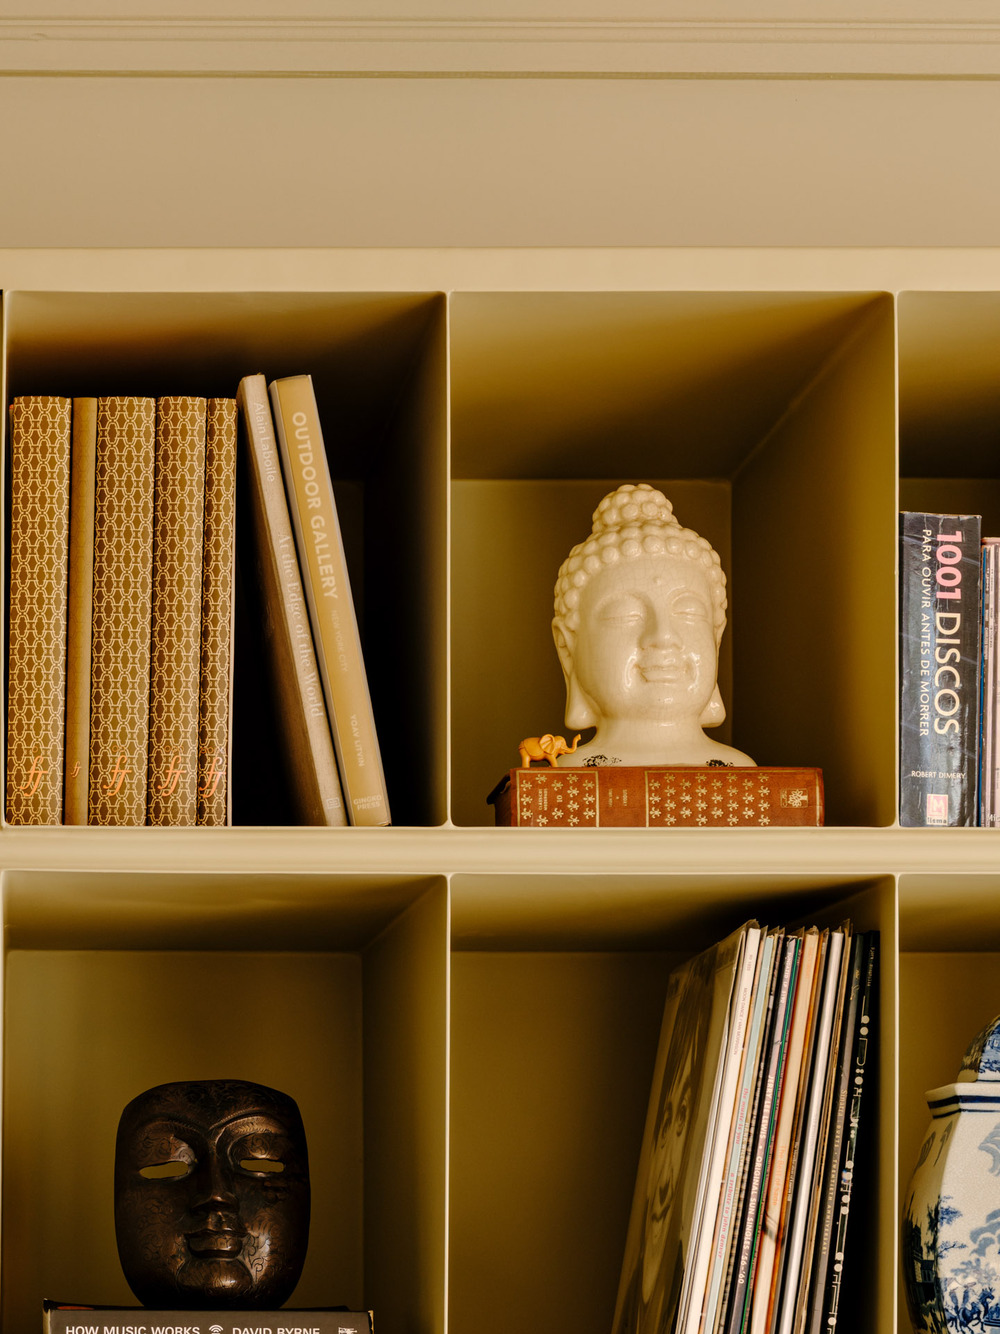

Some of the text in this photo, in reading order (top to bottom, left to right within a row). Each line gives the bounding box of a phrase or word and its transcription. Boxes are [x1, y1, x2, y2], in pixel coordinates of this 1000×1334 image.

[251, 400, 278, 482] Alain Laboile
[291, 410, 338, 599] OUTDOOR GALLERY
[277, 533, 323, 717] At the Edge of the World
[332, 624, 348, 672] YORK CITY
[920, 529, 932, 737] PARA OUVIR ANTES DE MORRER
[934, 531, 962, 735] 1001 DISCOS
[348, 713, 364, 766] YOAV LITVIN
[911, 770, 966, 780] ROBERT DIMERY
[742, 1074, 774, 1249] JERRY LEE LEWIS ORIGINAL SUN SINGLES
[821, 1159, 837, 1255] TWENTIETH ANNIVERSARY
[717, 1179, 734, 1258] tribute john denver
